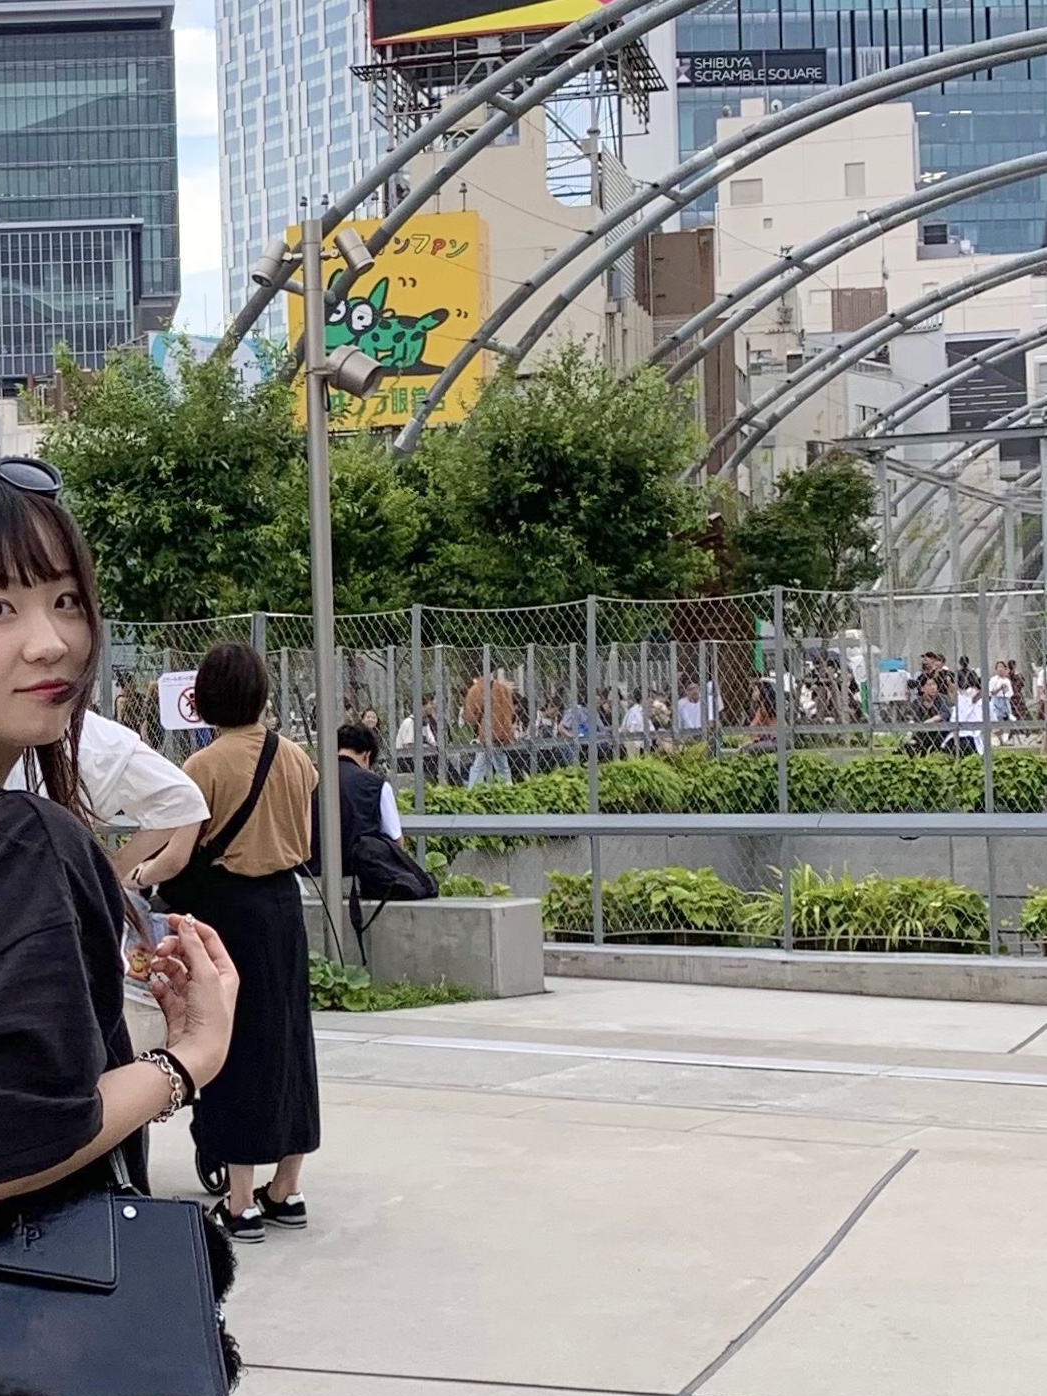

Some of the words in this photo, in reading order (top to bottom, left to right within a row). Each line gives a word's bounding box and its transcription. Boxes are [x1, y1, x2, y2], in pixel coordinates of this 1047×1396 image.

[694, 57, 753, 69] SHIBUYA
[694, 68, 766, 82] SCRAMBLE
[768, 67, 823, 80] SQUARE
